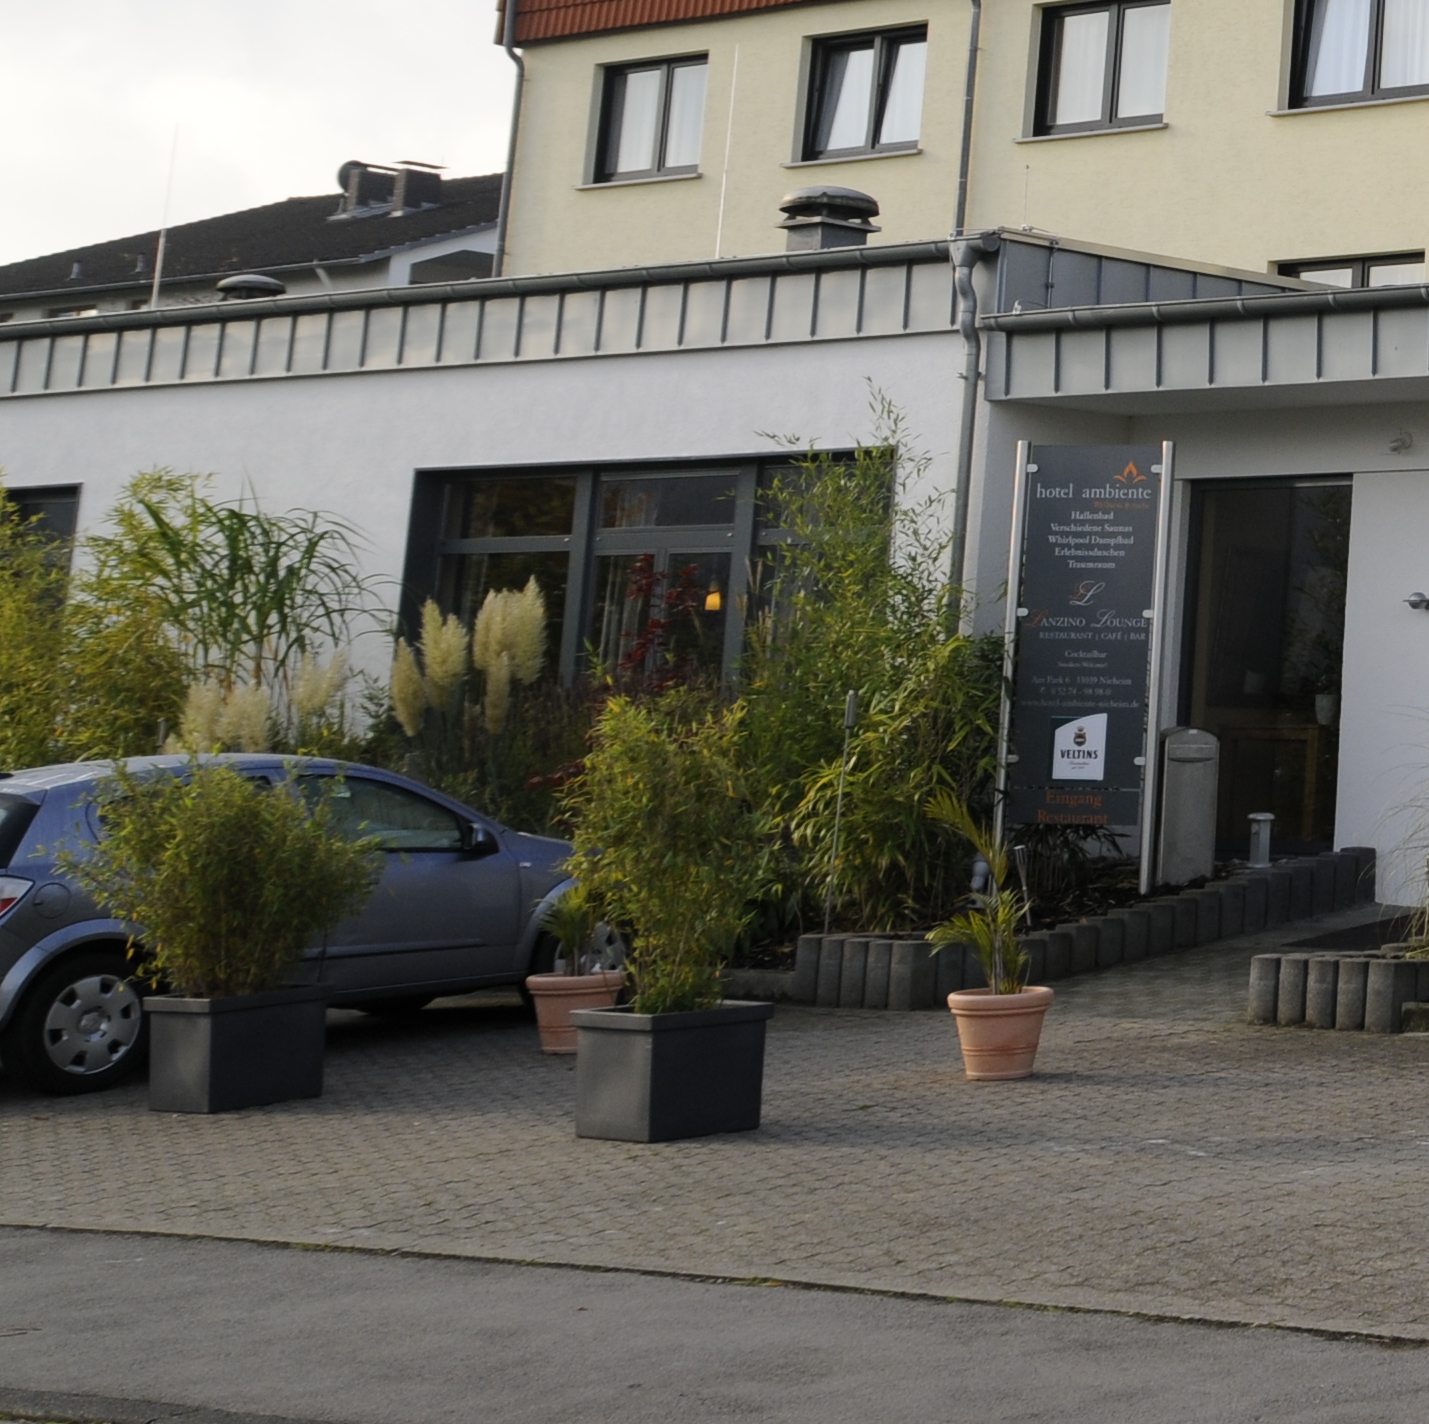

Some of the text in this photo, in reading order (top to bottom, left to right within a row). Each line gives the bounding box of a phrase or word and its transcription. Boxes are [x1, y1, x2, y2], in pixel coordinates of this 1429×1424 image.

[1036, 483, 1152, 499] hotel ambiente
[1070, 511, 1114, 520] Hallenbad
[1050, 522, 1133, 532] Verschiedene Saunas
[1047, 535, 1134, 546] Whirlpool Dampfbad
[1067, 559, 1116, 569] Traumraum
[1039, 631, 1146, 641] RESTAURANT CAFÉ BAR
[1060, 749, 1099, 760] VELTINS
[1045, 791, 1103, 807] Eingang
[1037, 809, 1110, 823] Restaurant
